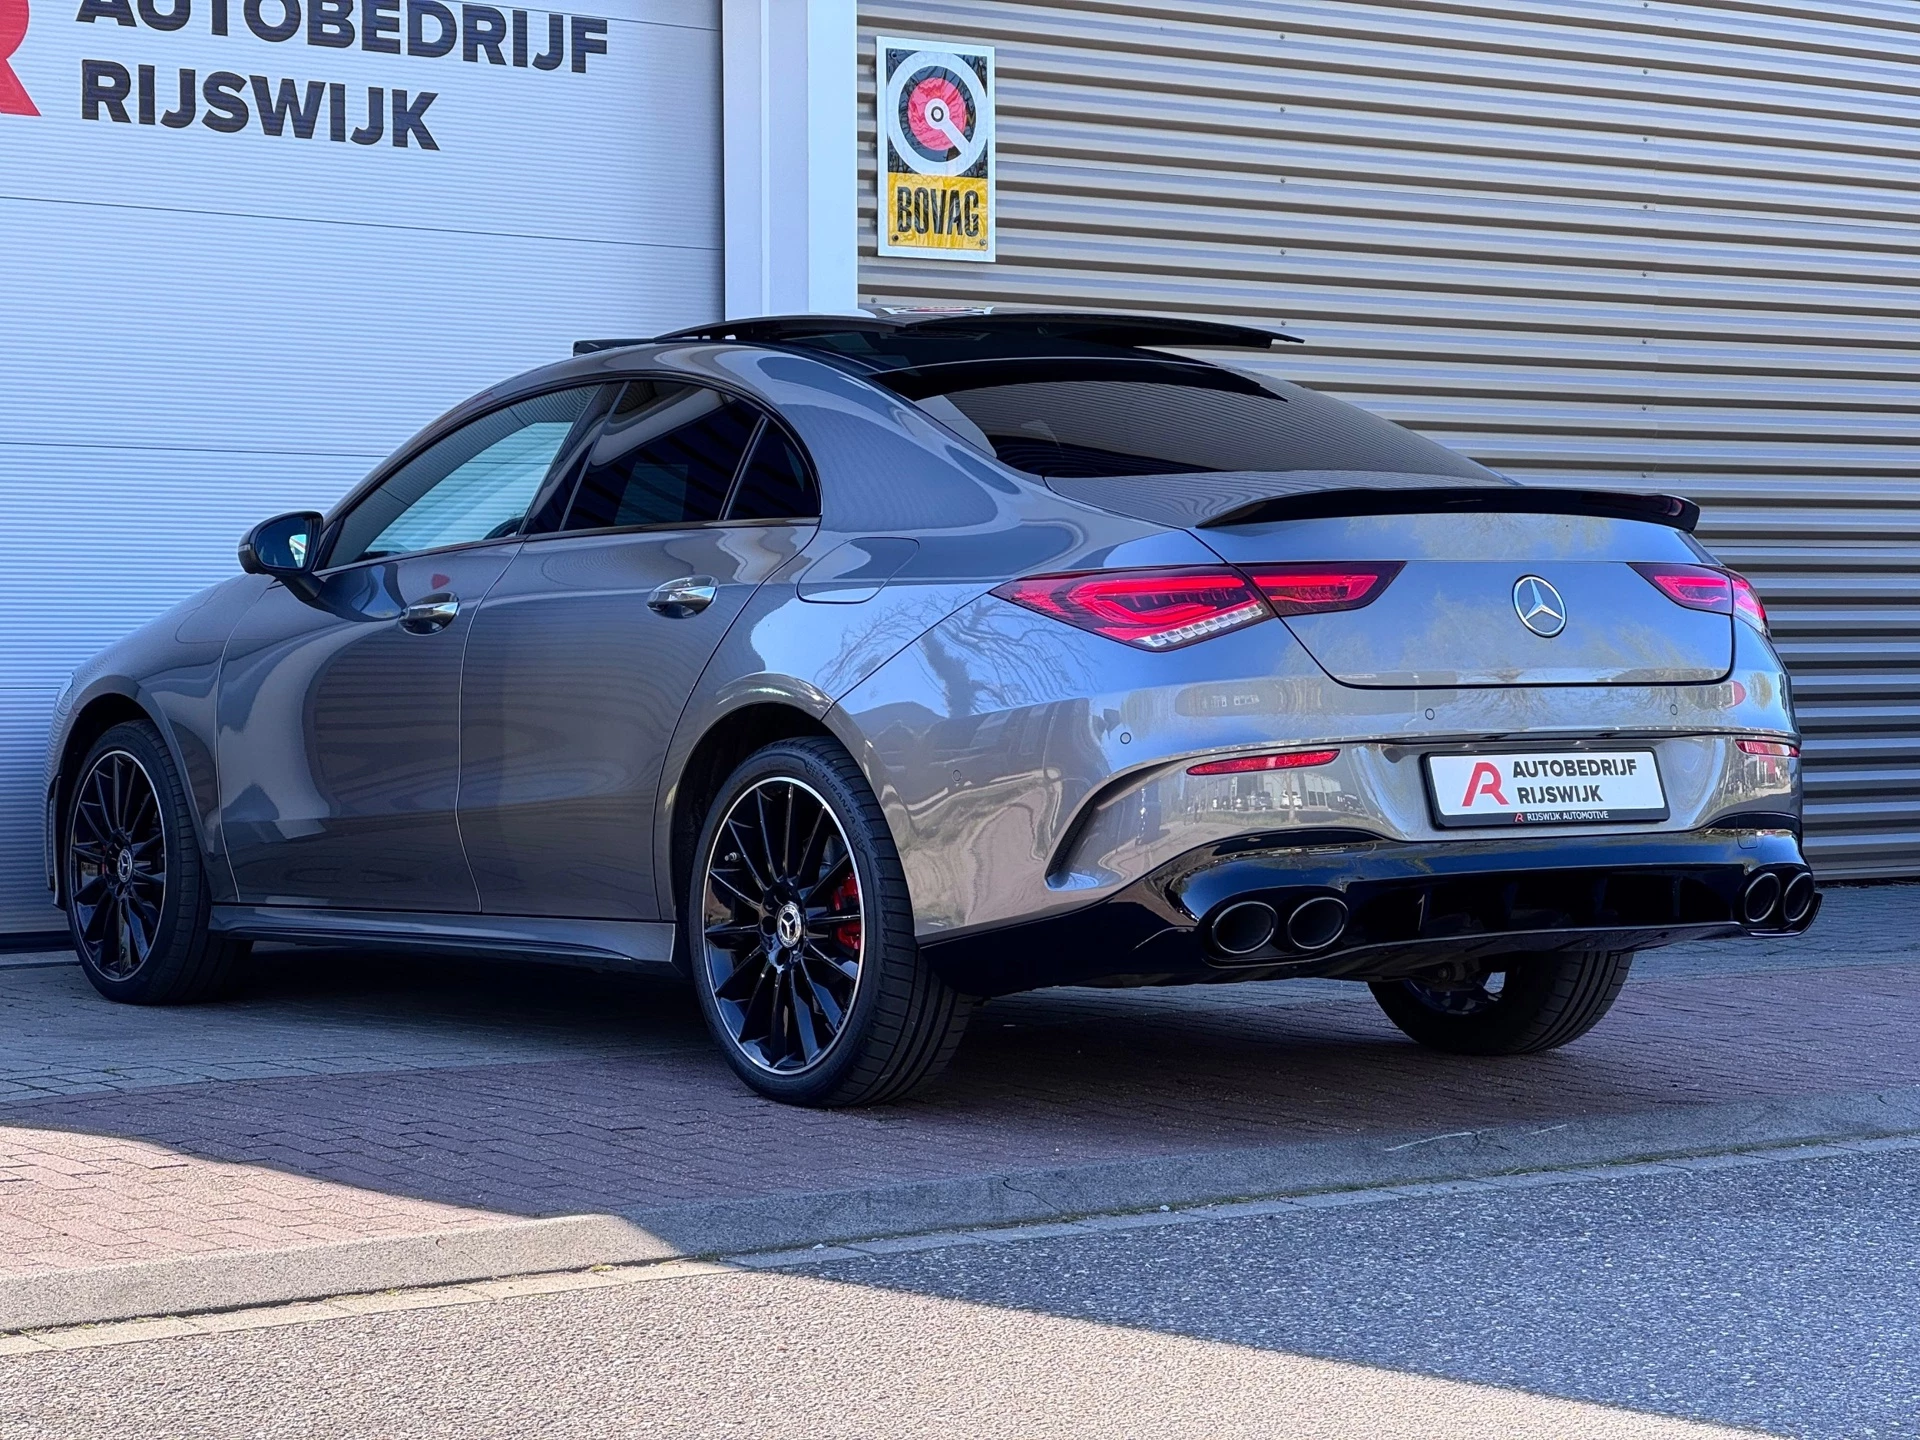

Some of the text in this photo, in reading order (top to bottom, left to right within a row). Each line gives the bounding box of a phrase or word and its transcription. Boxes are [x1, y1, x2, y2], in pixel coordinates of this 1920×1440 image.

[82, 59, 440, 151] RIJSWIJK
[896, 186, 980, 236] BOVAG
[1513, 758, 1638, 778] AUTOBEDRIJF
[821, 773, 857, 825] TURANZA
[1517, 785, 1604, 804] RIJSWIJK
[1526, 812, 1562, 822] RIJSWIJK
[1562, 810, 1609, 820] AUTOMOTIVE
